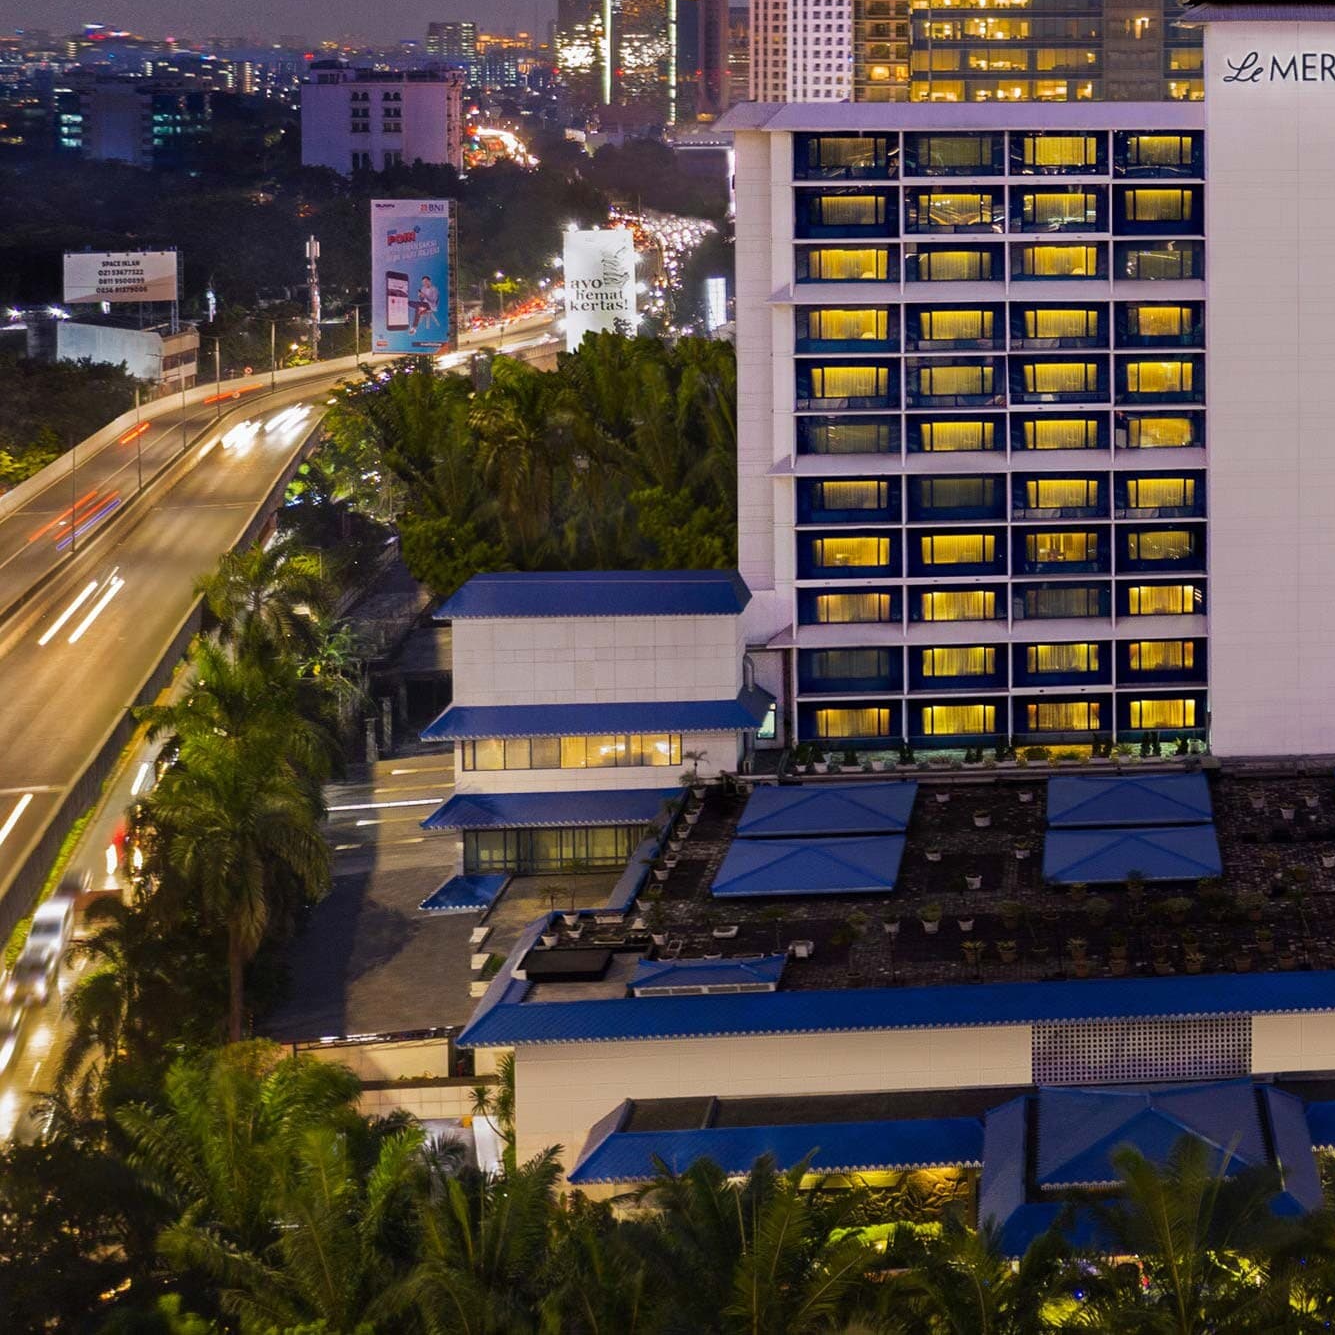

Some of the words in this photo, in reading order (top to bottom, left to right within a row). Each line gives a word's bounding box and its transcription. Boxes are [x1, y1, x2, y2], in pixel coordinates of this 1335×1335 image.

[1223, 52, 1264, 82] Le
[429, 204, 444, 212] BNI
[570, 279, 602, 291] ayo
[576, 288, 623, 300] hemat
[570, 299, 628, 311] kertas!
